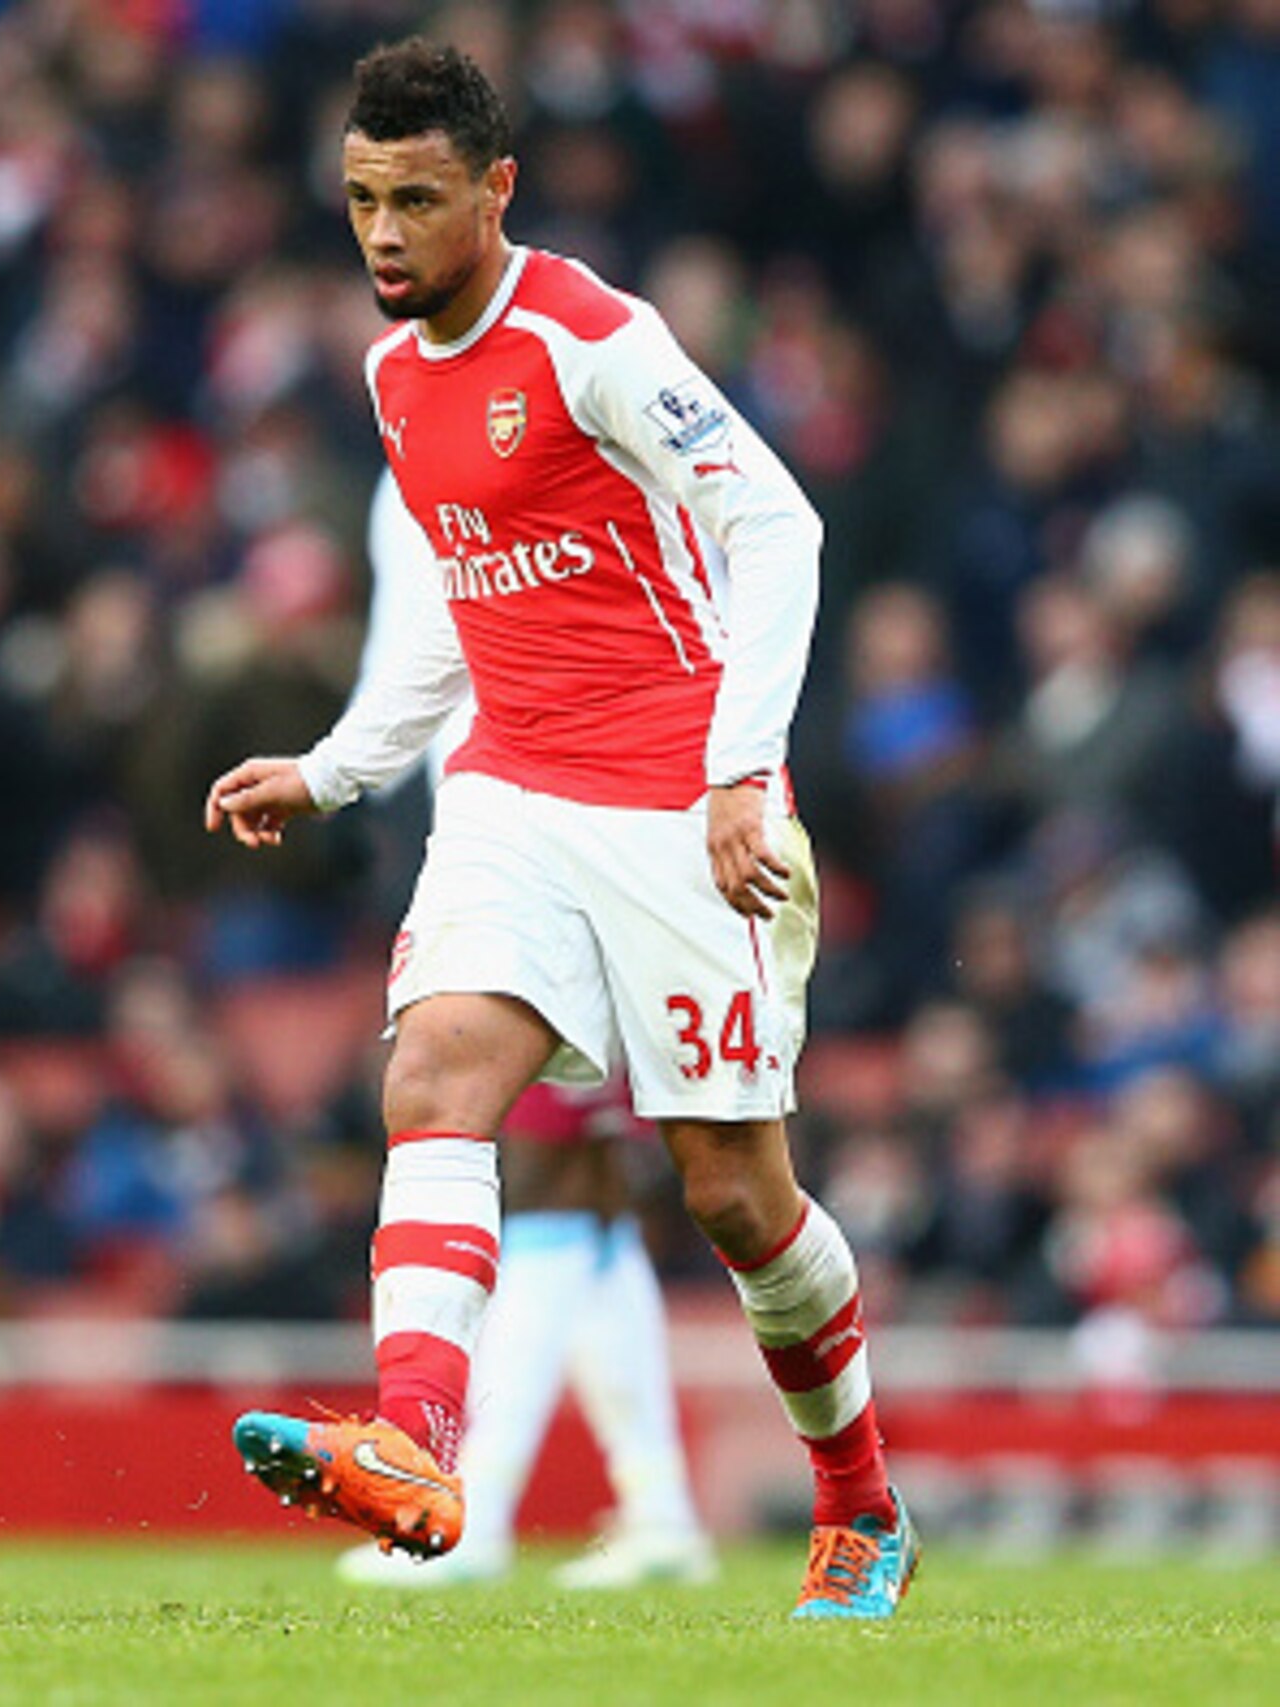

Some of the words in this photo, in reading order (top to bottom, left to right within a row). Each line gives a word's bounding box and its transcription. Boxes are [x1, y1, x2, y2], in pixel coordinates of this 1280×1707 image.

[436, 503, 492, 545] Fly
[436, 530, 595, 600] mirates
[666, 990, 761, 1081] 34
